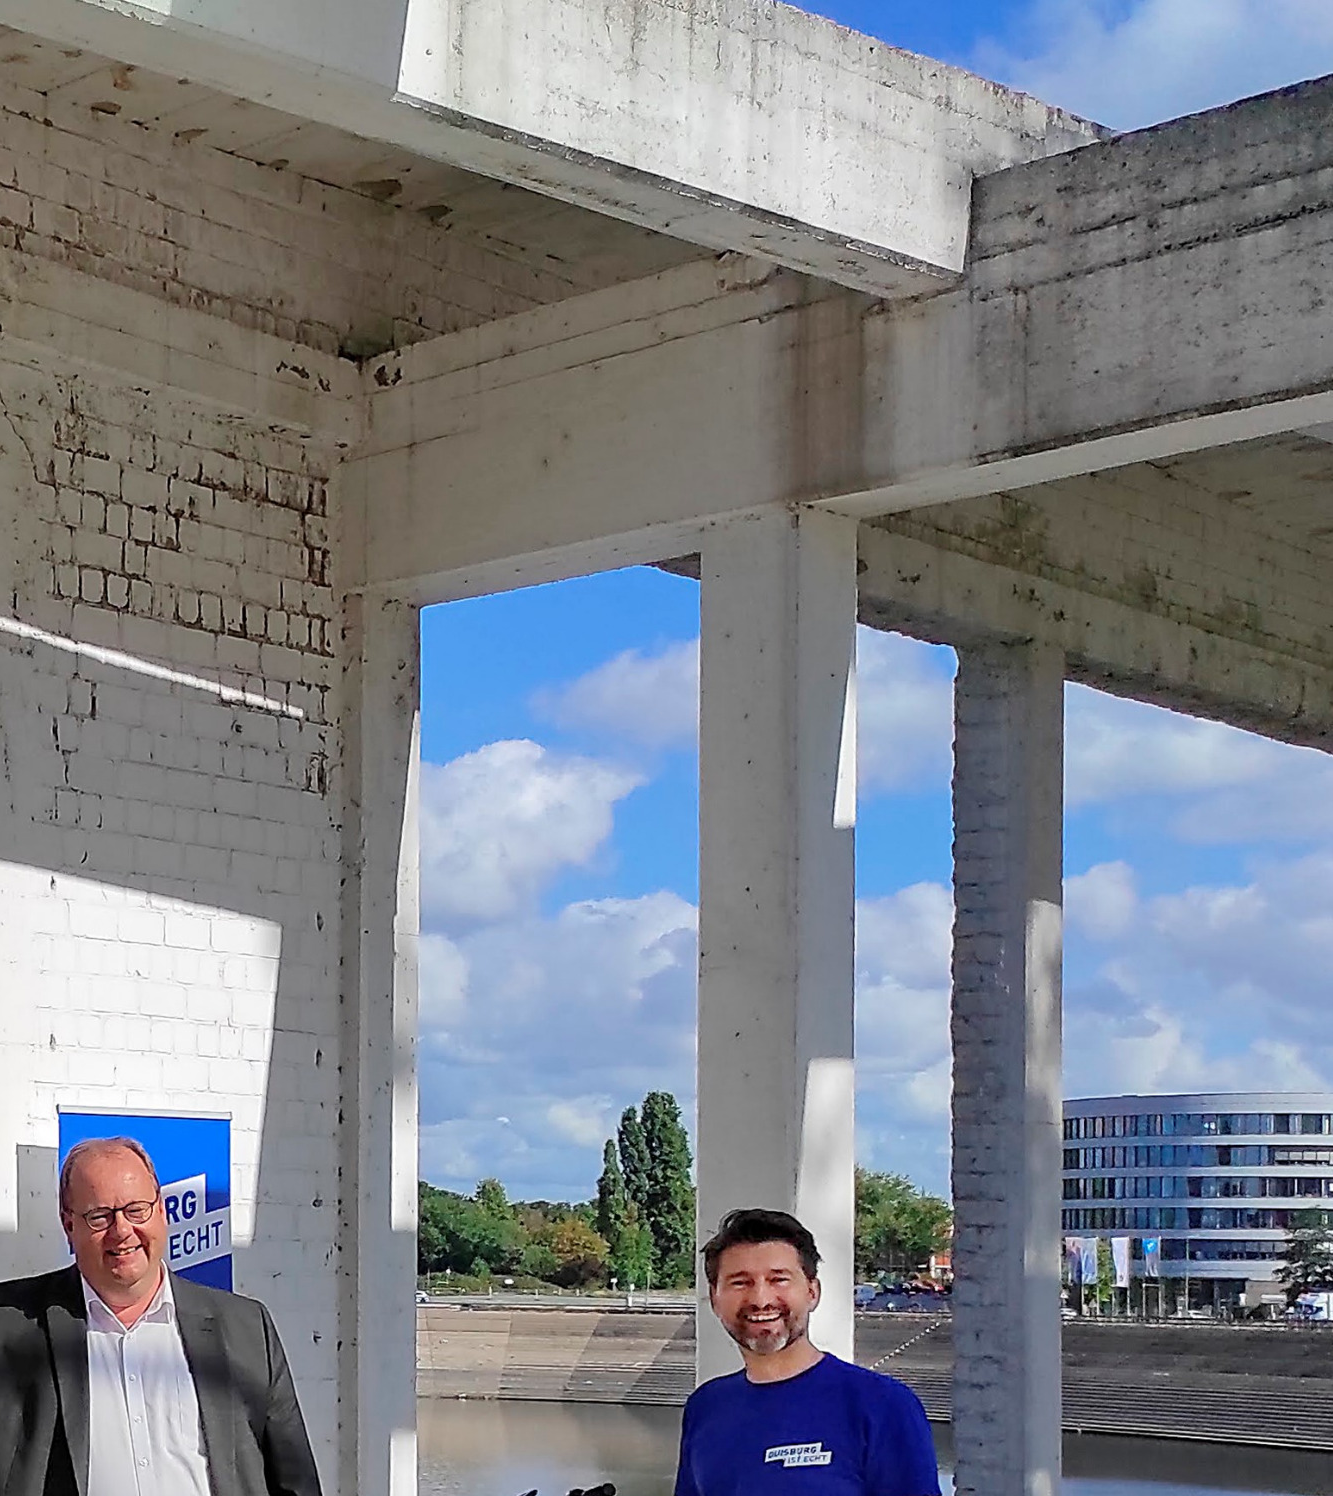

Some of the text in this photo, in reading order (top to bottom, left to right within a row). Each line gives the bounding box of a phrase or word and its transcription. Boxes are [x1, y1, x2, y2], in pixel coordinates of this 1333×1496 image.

[169, 1220, 223, 1261] ECHT
[768, 1446, 817, 1459] DUISBURG
[803, 1454, 827, 1463] ECHT
